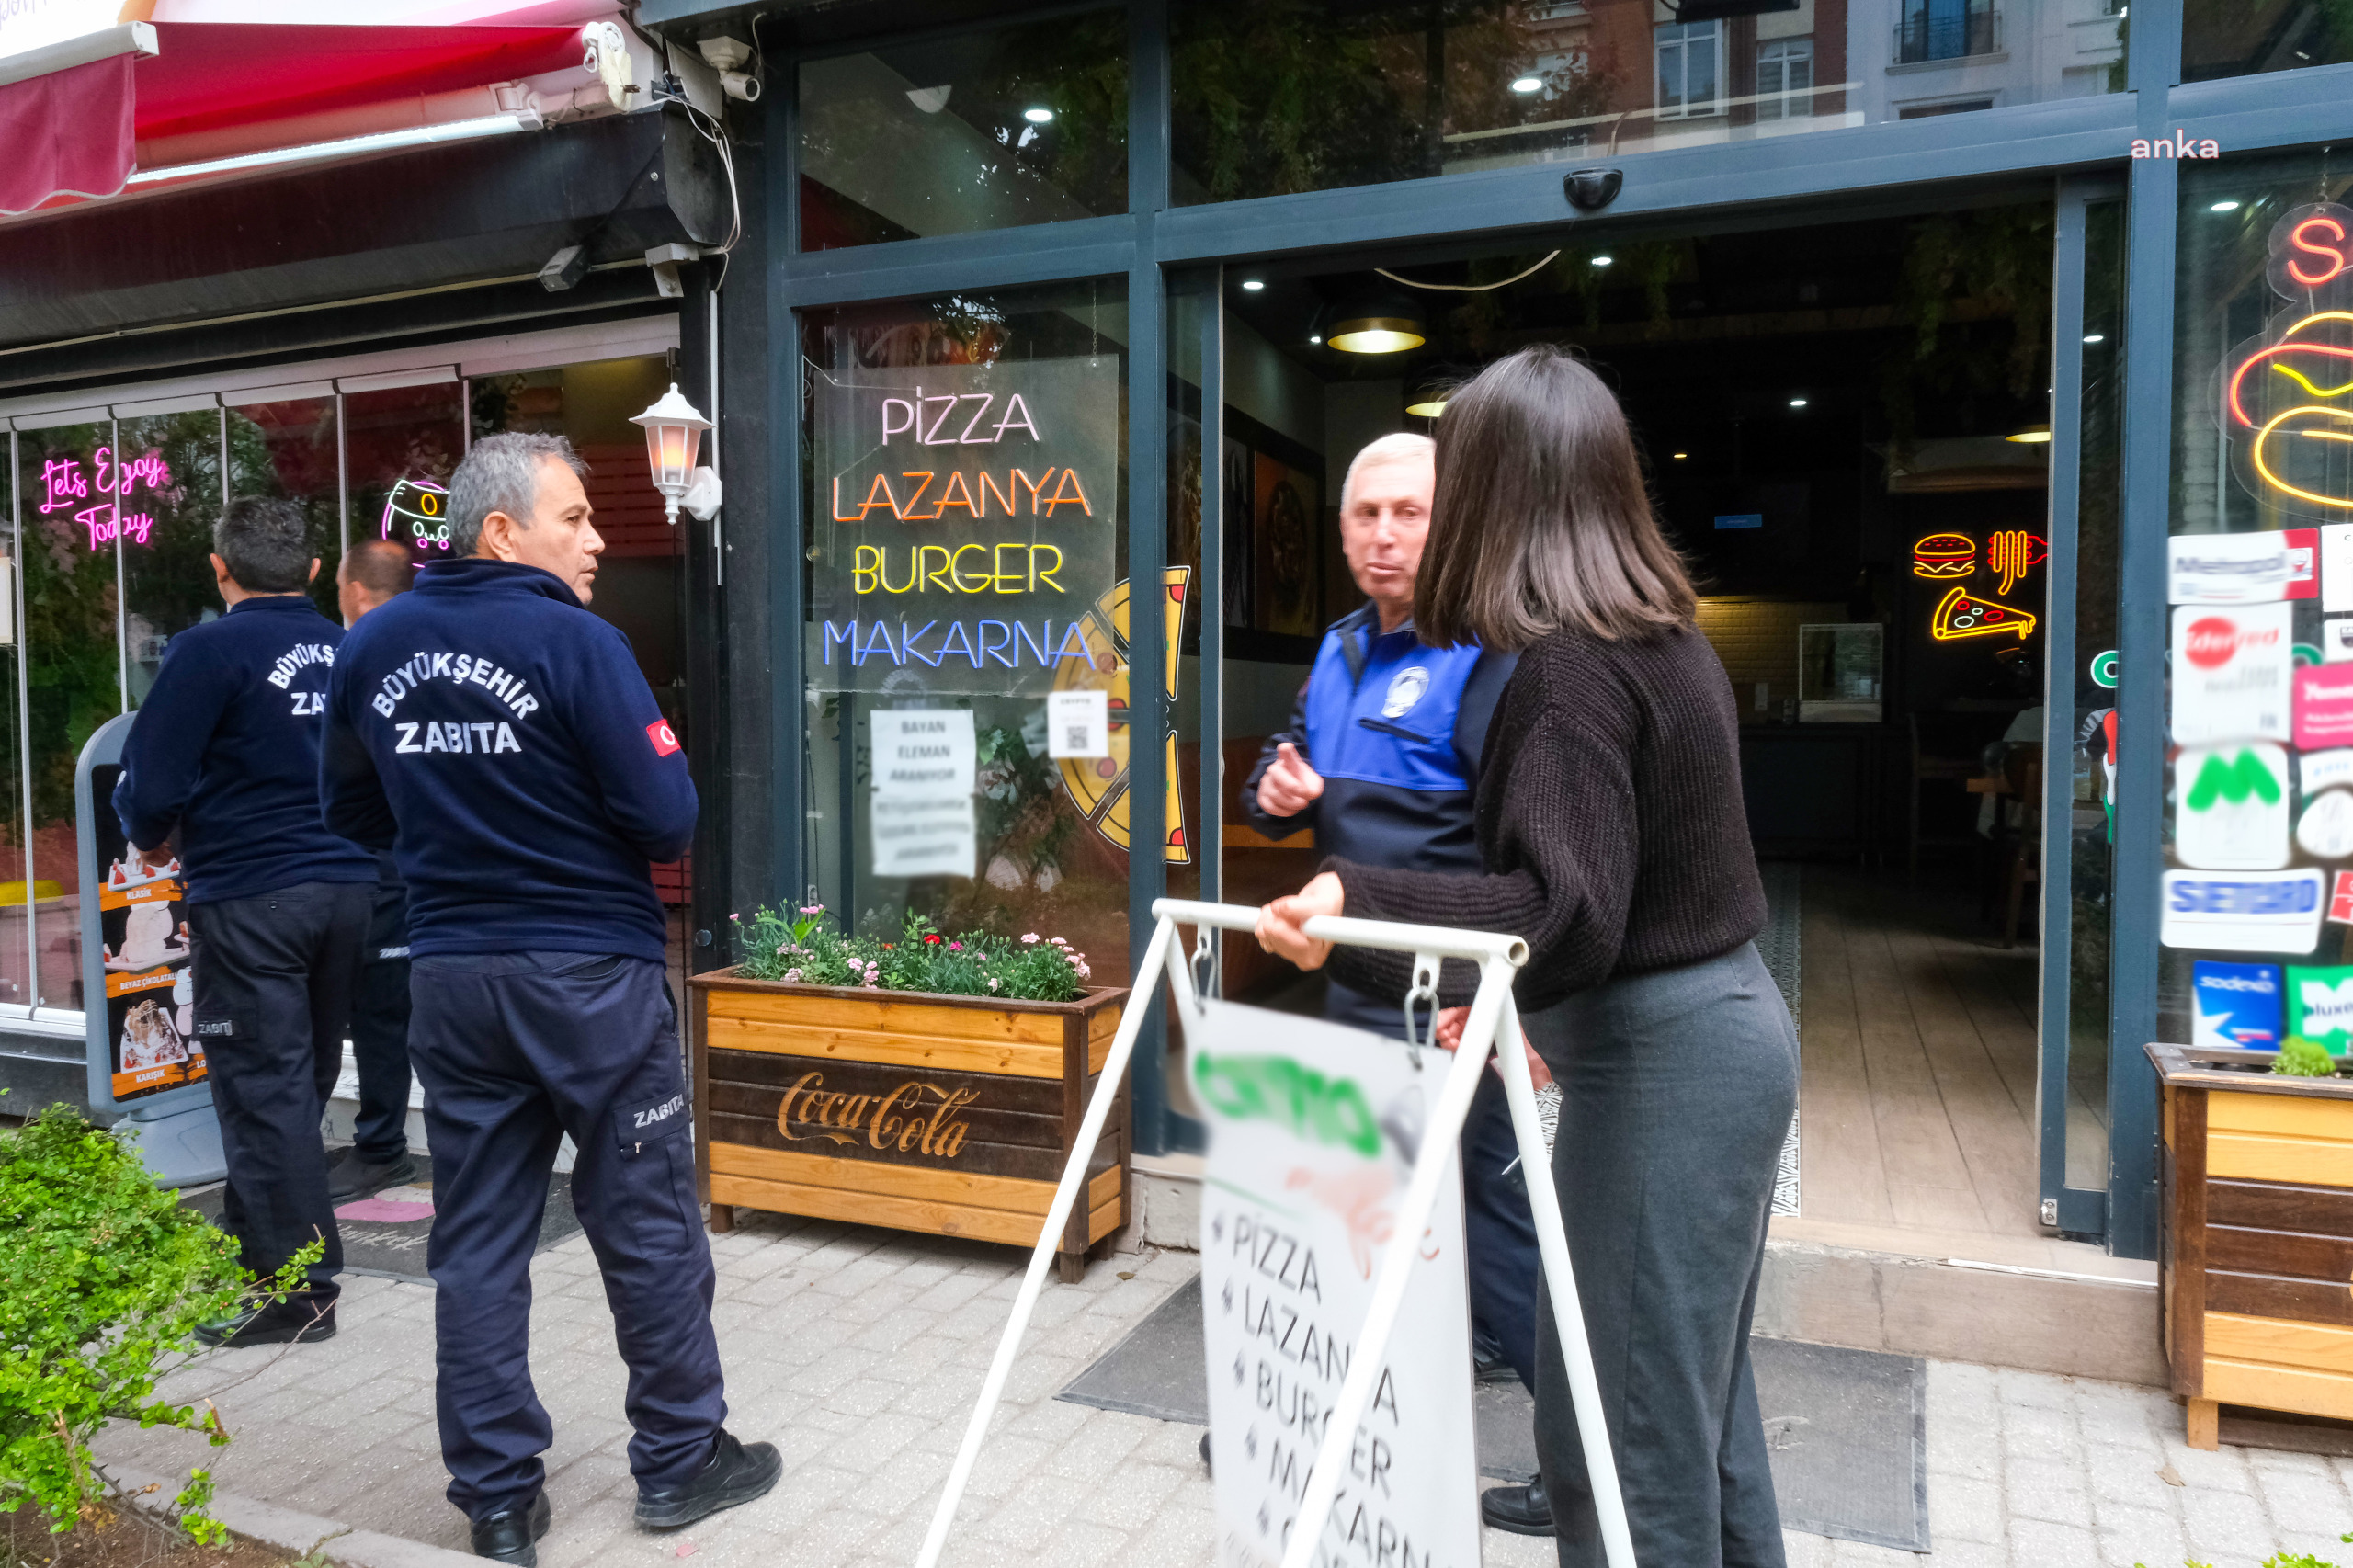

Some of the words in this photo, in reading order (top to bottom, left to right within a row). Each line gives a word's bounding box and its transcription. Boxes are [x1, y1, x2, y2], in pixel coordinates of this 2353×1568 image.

[882, 386, 1040, 445] PİZZA
[95, 447, 163, 494] Ejoy
[834, 467, 1091, 521] LAZANYA
[851, 544, 1065, 594] BURGER
[267, 643, 336, 689] BÜYÜKŞ
[824, 619, 1096, 670] MAKARNA
[372, 651, 540, 720] BÜYÜKŞEHİR
[395, 721, 522, 754] ZABITA
[126, 888, 152, 900] KLASİK
[119, 981, 142, 991] BEYAZ
[633, 1094, 684, 1129] ZABITA
[1245, 1284, 1399, 1428] LAZANA
